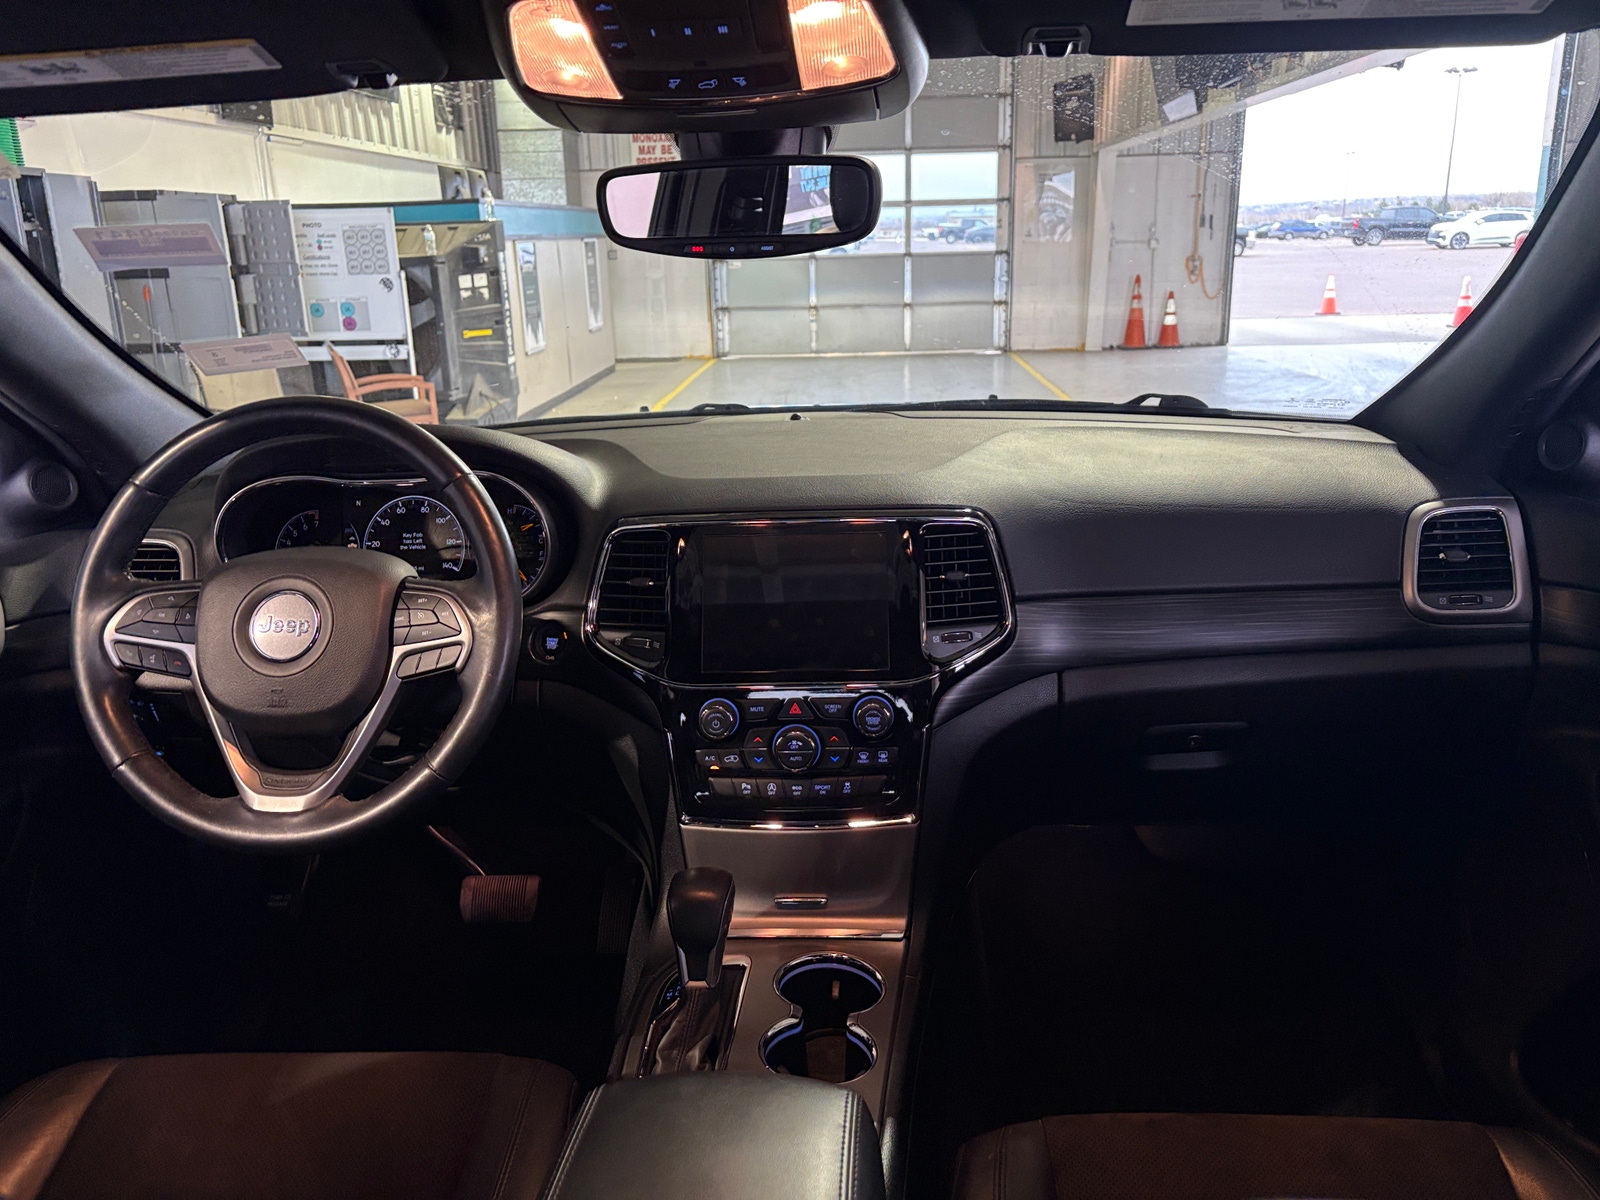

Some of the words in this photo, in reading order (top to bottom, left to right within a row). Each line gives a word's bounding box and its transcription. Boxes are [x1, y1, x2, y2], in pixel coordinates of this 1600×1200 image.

[638, 145, 656, 155] MAY
[661, 144, 673, 154] BE
[396, 506, 406, 514] 60
[314, 520, 319, 528] 7
[380, 518, 390, 526] 40
[303, 522, 308, 531] 6
[371, 540, 381, 548] 20
[442, 561, 453, 569] 140
[258, 615, 311, 637] Jeep
